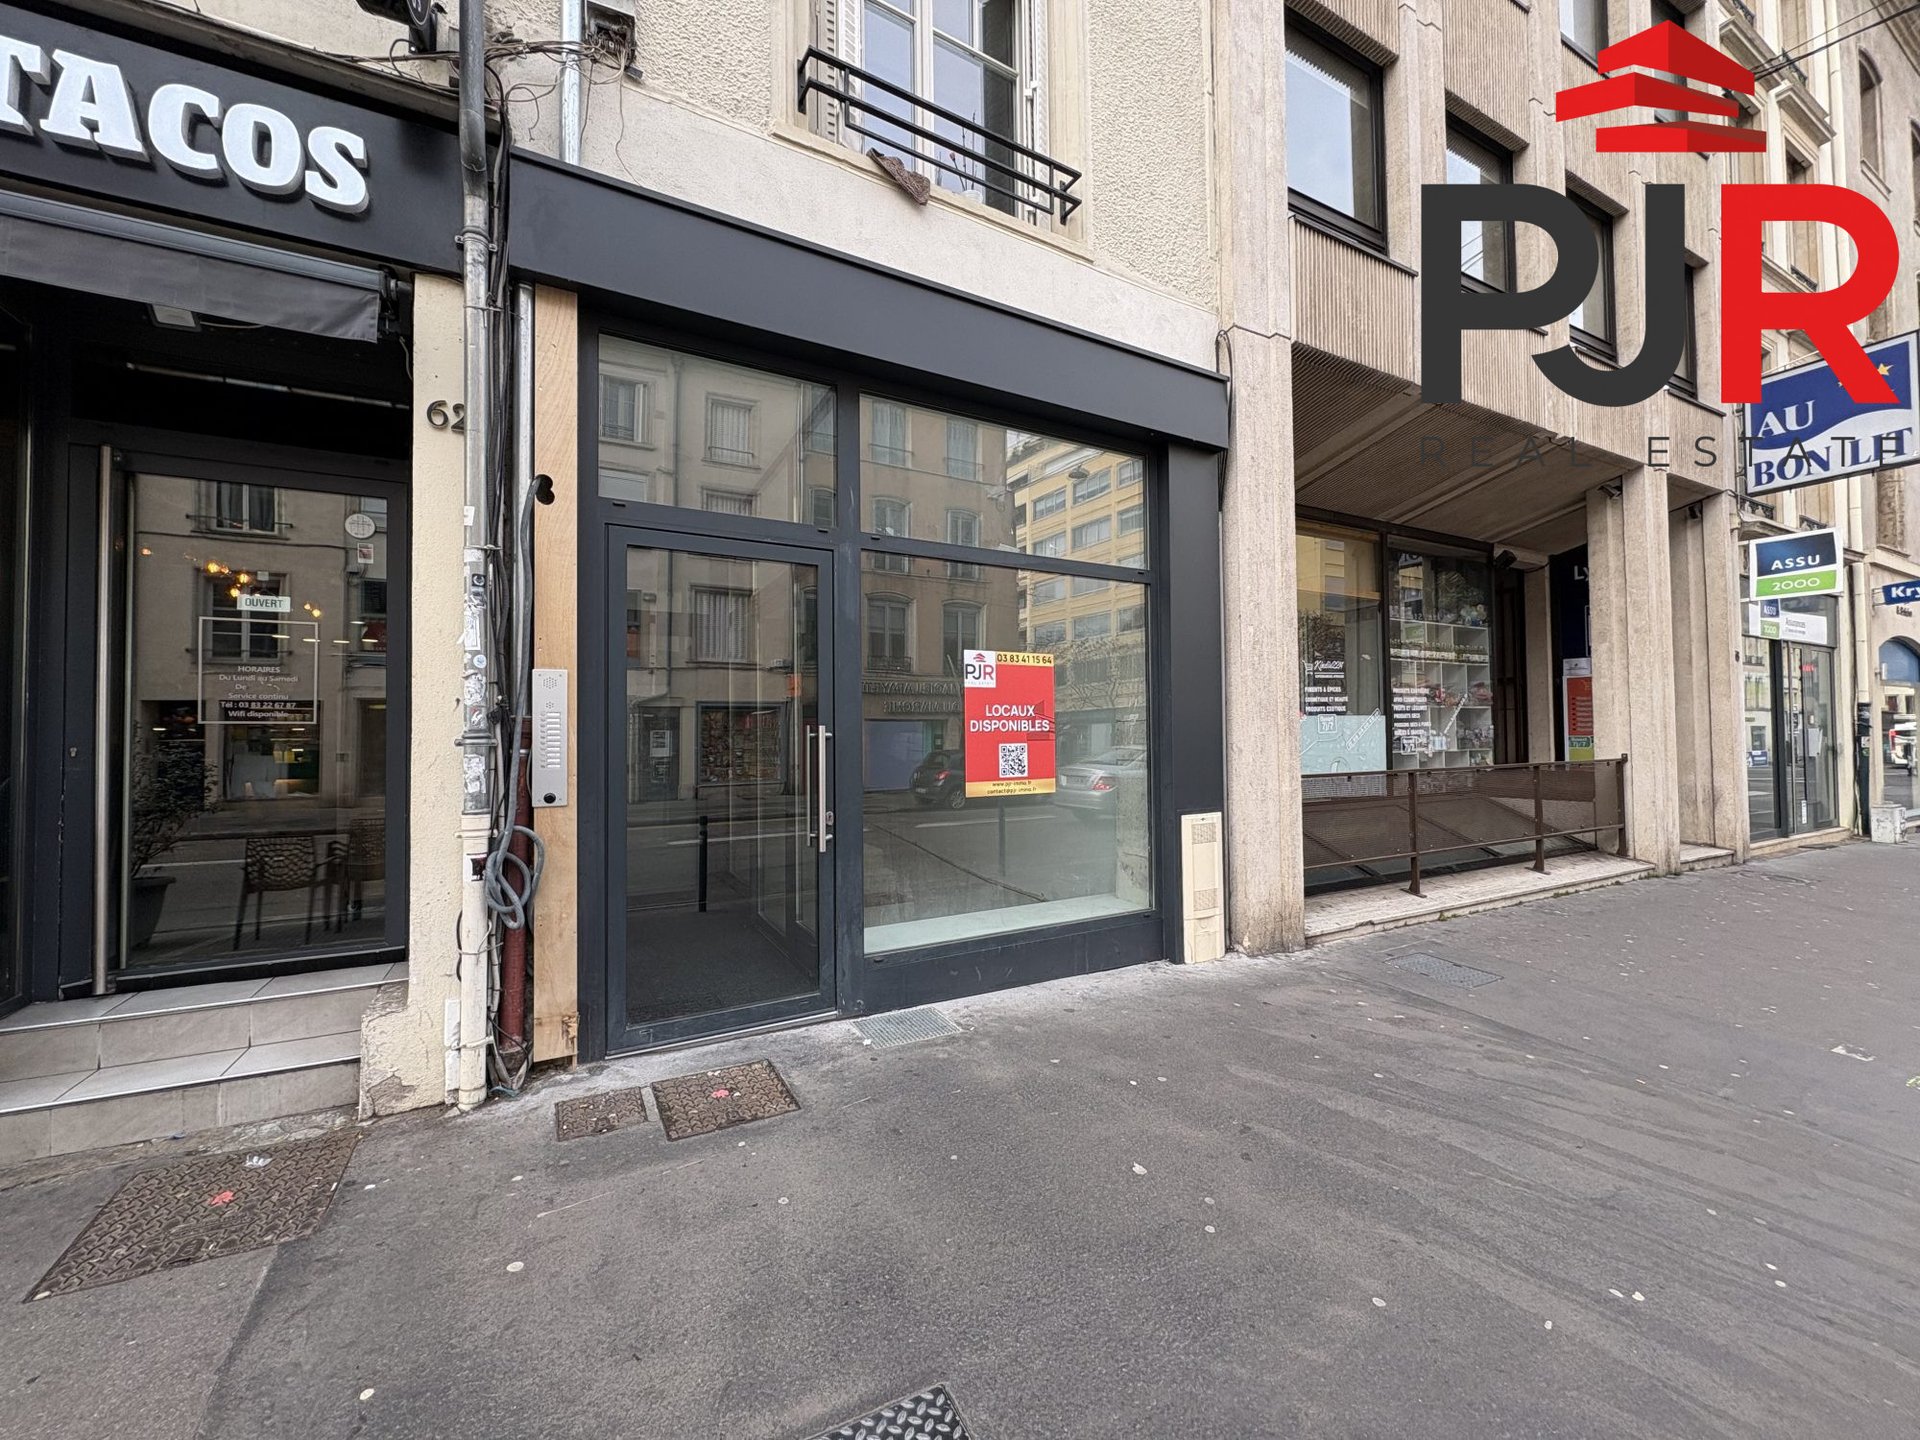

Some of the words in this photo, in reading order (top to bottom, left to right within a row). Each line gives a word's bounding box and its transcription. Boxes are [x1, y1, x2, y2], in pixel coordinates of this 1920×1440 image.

[0, 36, 370, 213] TACOS
[426, 400, 465, 434] 62
[1757, 399, 1817, 438] AU
[1753, 444, 1832, 488] BON
[1849, 426, 1914, 467] LIT
[1771, 554, 1821, 571] ASSU
[1772, 577, 1820, 593] 2000
[245, 597, 284, 609] OUVERT
[996, 653, 1008, 663] 03
[1009, 654, 1020, 663] 83
[1021, 655, 1030, 664] 41
[1032, 655, 1041, 664] 15
[1041, 656, 1052, 664] 64
[237, 665, 281, 673] HORAIRES
[965, 663, 995, 681] PJR
[232, 673, 256, 681] Lundi
[269, 674, 299, 683] Samedi
[228, 692, 257, 700] Service
[238, 701, 249, 709] 03
[250, 701, 262, 709] 83
[262, 701, 273, 709] 22
[985, 704, 1036, 717] LOCAUX
[228, 710, 245, 718] Wifi
[246, 710, 289, 719] disponible
[970, 719, 1050, 732] DISPONIBLES
